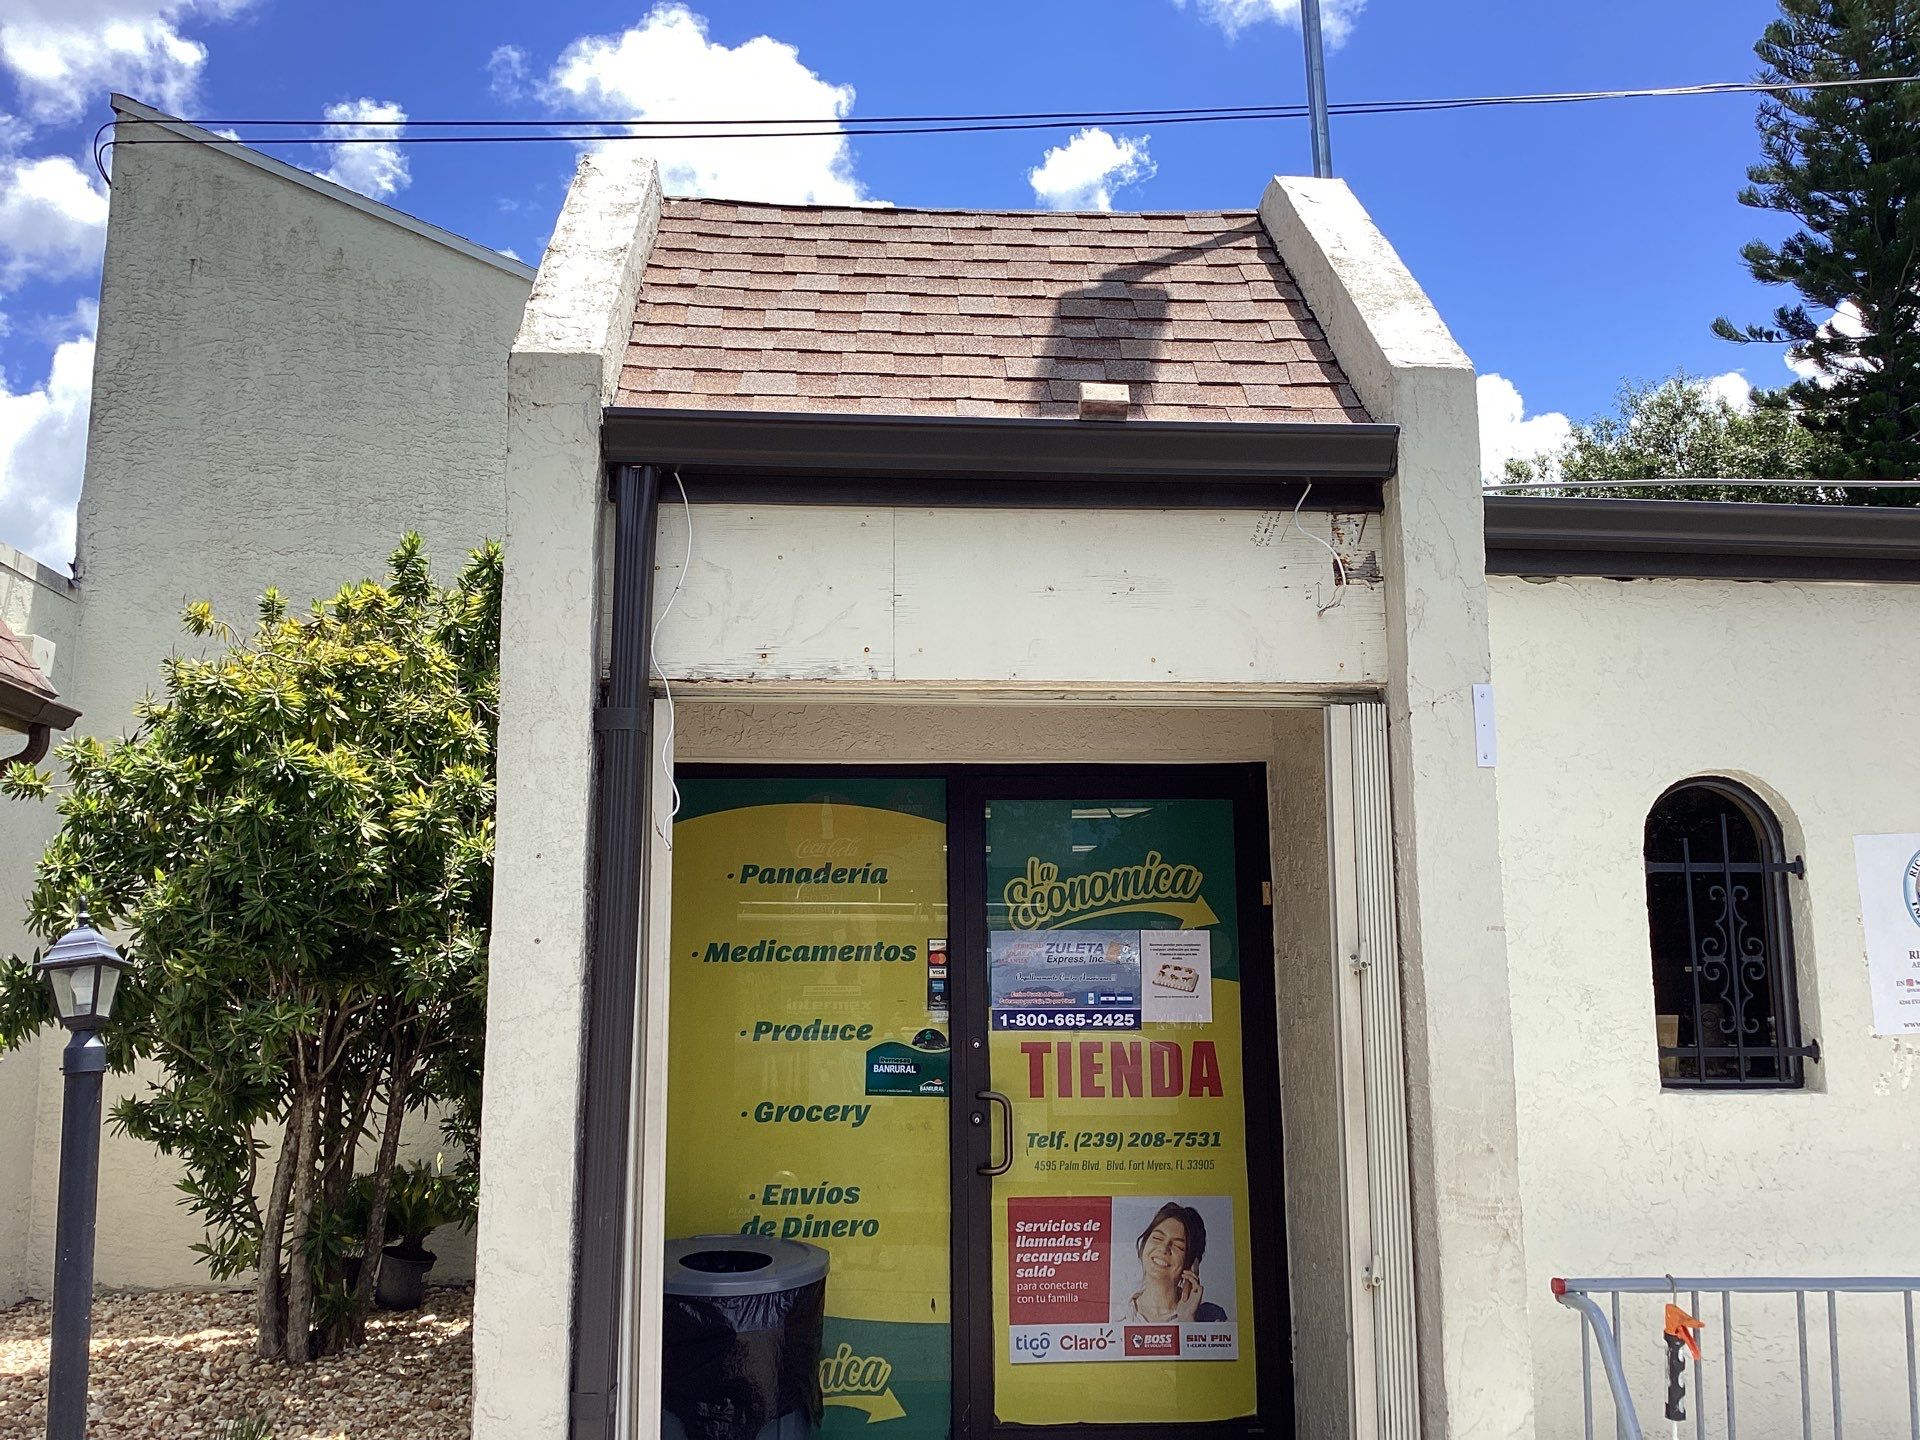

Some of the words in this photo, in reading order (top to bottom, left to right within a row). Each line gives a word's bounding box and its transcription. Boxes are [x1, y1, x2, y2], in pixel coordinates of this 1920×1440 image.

[740, 862, 888, 885] Panadería
[704, 940, 917, 962] Medicamentos
[1045, 942, 1104, 954] ZULETA
[1046, 955, 1086, 964] Express,
[1000, 1013, 1135, 1027] 1-800-665-2425
[753, 1019, 873, 1041] Produce
[873, 1064, 916, 1074] BANRURAL
[1020, 1041, 1224, 1098] TIENDA
[754, 1101, 871, 1128] Grocery
[1027, 1131, 1069, 1149] Telf.
[1073, 1132, 1123, 1152] (239)
[1127, 1132, 1222, 1148] 208-7531
[1034, 1160, 1057, 1171] 4595
[1059, 1160, 1079, 1171] Palm
[1128, 1160, 1144, 1171] Fort
[1147, 1160, 1173, 1172] Myers,
[1186, 1159, 1215, 1170] 33905
[761, 1181, 861, 1206] Envíos
[740, 1216, 777, 1237] de
[781, 1214, 880, 1239] Dinero
[1016, 1220, 1081, 1232] Servicios
[1083, 1220, 1101, 1232] de
[1016, 1235, 1082, 1248] llamadas
[1083, 1237, 1093, 1249] y
[1016, 1252, 1080, 1265] recargas
[1082, 1249, 1100, 1262] de
[1016, 1266, 1056, 1278] saldo
[1017, 1283, 1037, 1292] para
[1039, 1281, 1089, 1290] conectarte
[1017, 1295, 1034, 1304] con
[1036, 1294, 1046, 1303] tu
[1048, 1293, 1079, 1303] familia
[1015, 1335, 1051, 1350] tigo
[1060, 1335, 1108, 1351] Claro
[1144, 1334, 1173, 1344] BOSS
[1186, 1334, 1207, 1342] SIN
[1210, 1334, 1232, 1342] PIN
